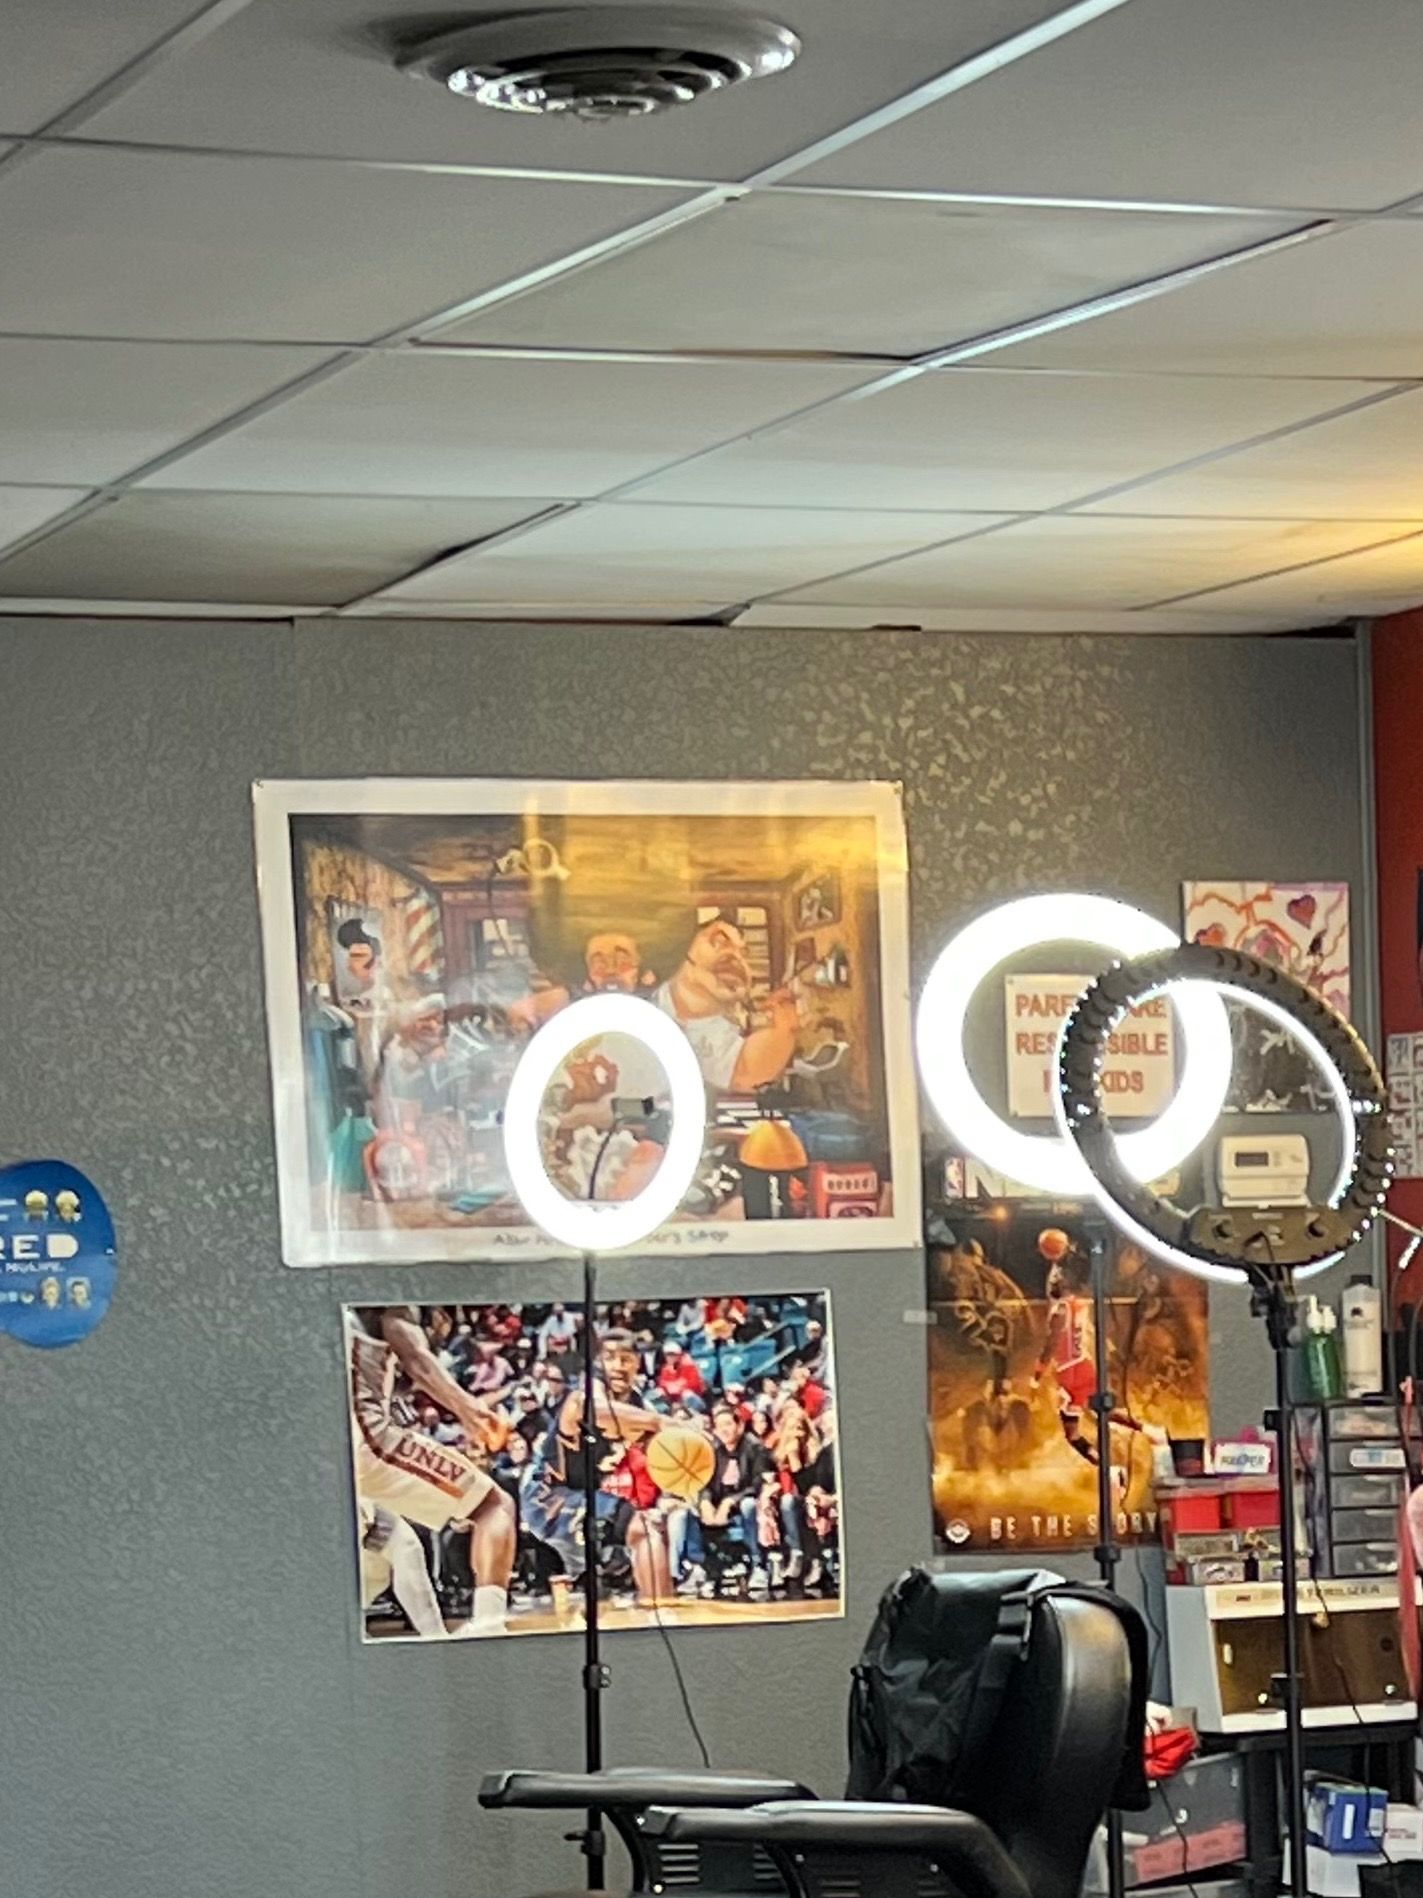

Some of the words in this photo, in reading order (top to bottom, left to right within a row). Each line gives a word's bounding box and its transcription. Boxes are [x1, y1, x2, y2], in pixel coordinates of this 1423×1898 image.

[990, 1516, 1016, 1540] BE
[1031, 1514, 1073, 1538] THE
[1086, 1511, 1158, 1536] SORY
